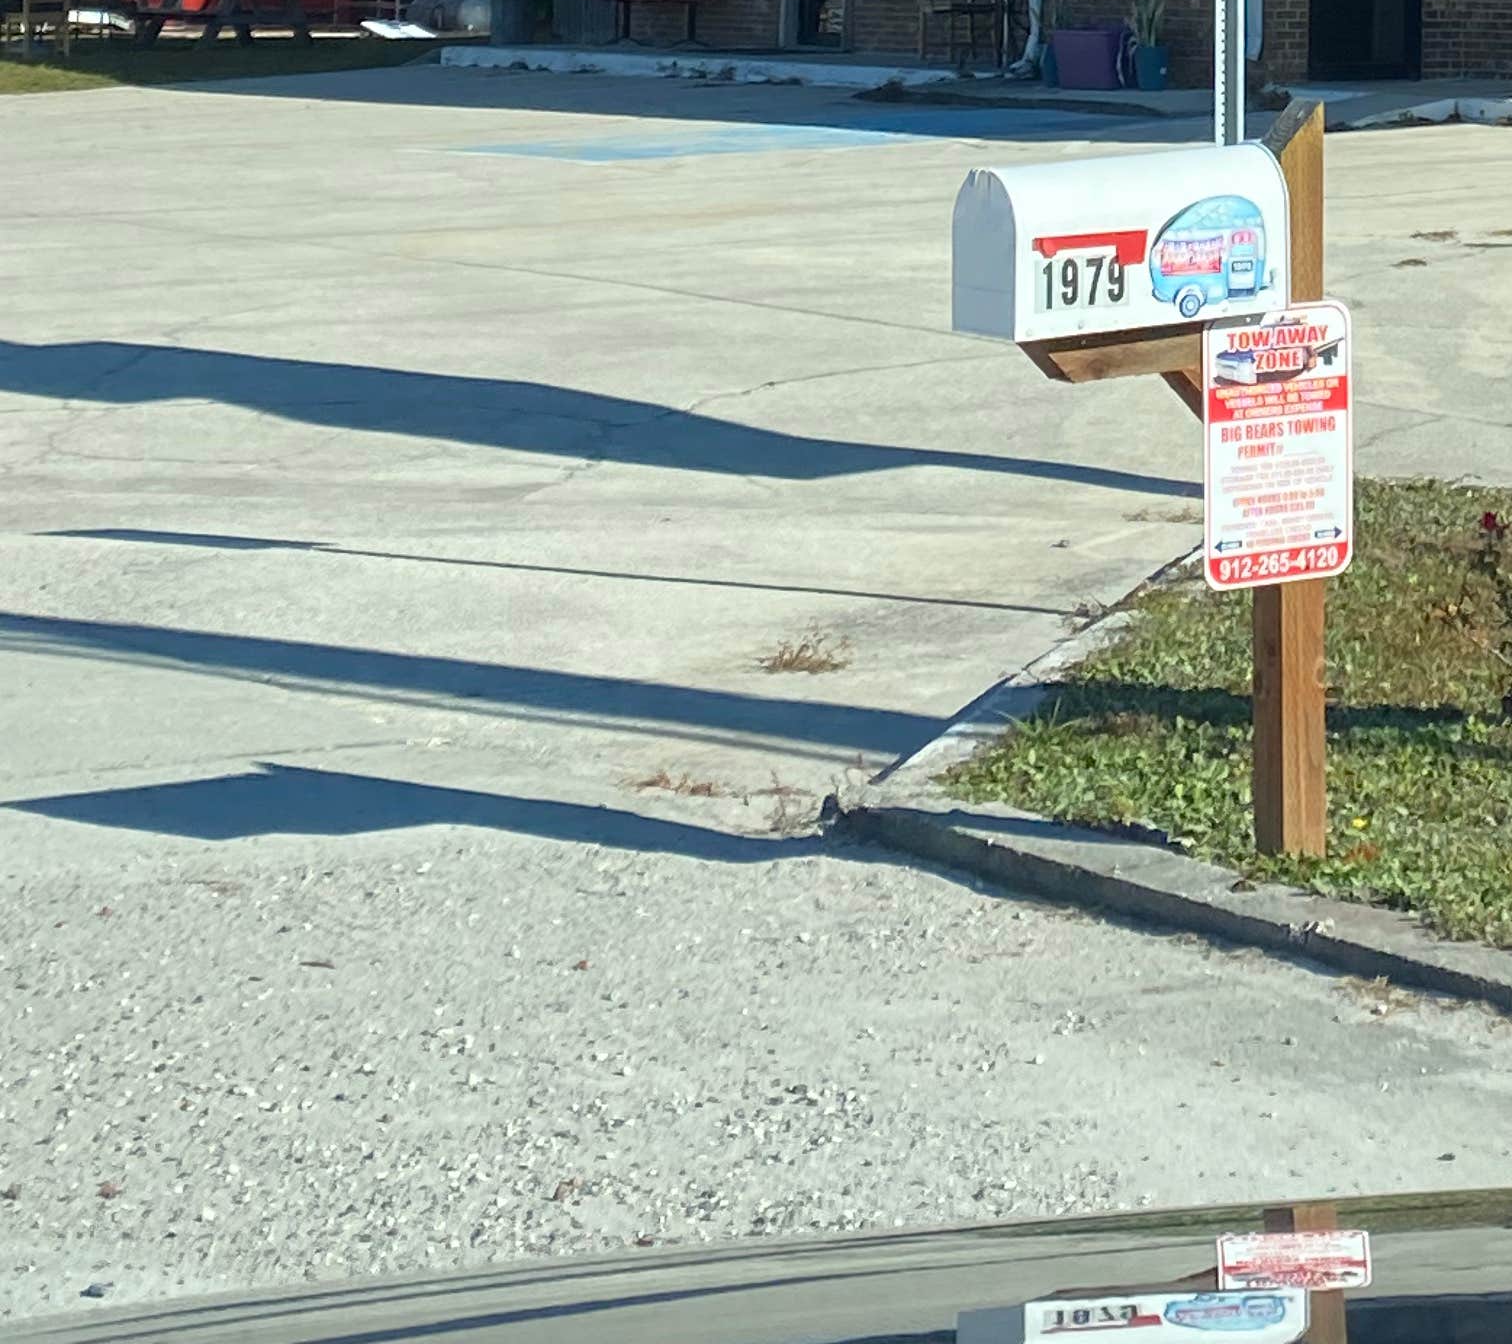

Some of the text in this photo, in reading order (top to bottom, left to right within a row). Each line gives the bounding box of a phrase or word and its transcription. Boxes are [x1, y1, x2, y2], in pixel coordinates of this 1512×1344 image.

[1042, 255, 1125, 310] 1979
[1227, 324, 1328, 350] TOW AWAY
[1255, 350, 1301, 371] ZONE
[1221, 416, 1336, 443] BIG BEARS TOWING
[1219, 546, 1339, 581] 912-265-4120
